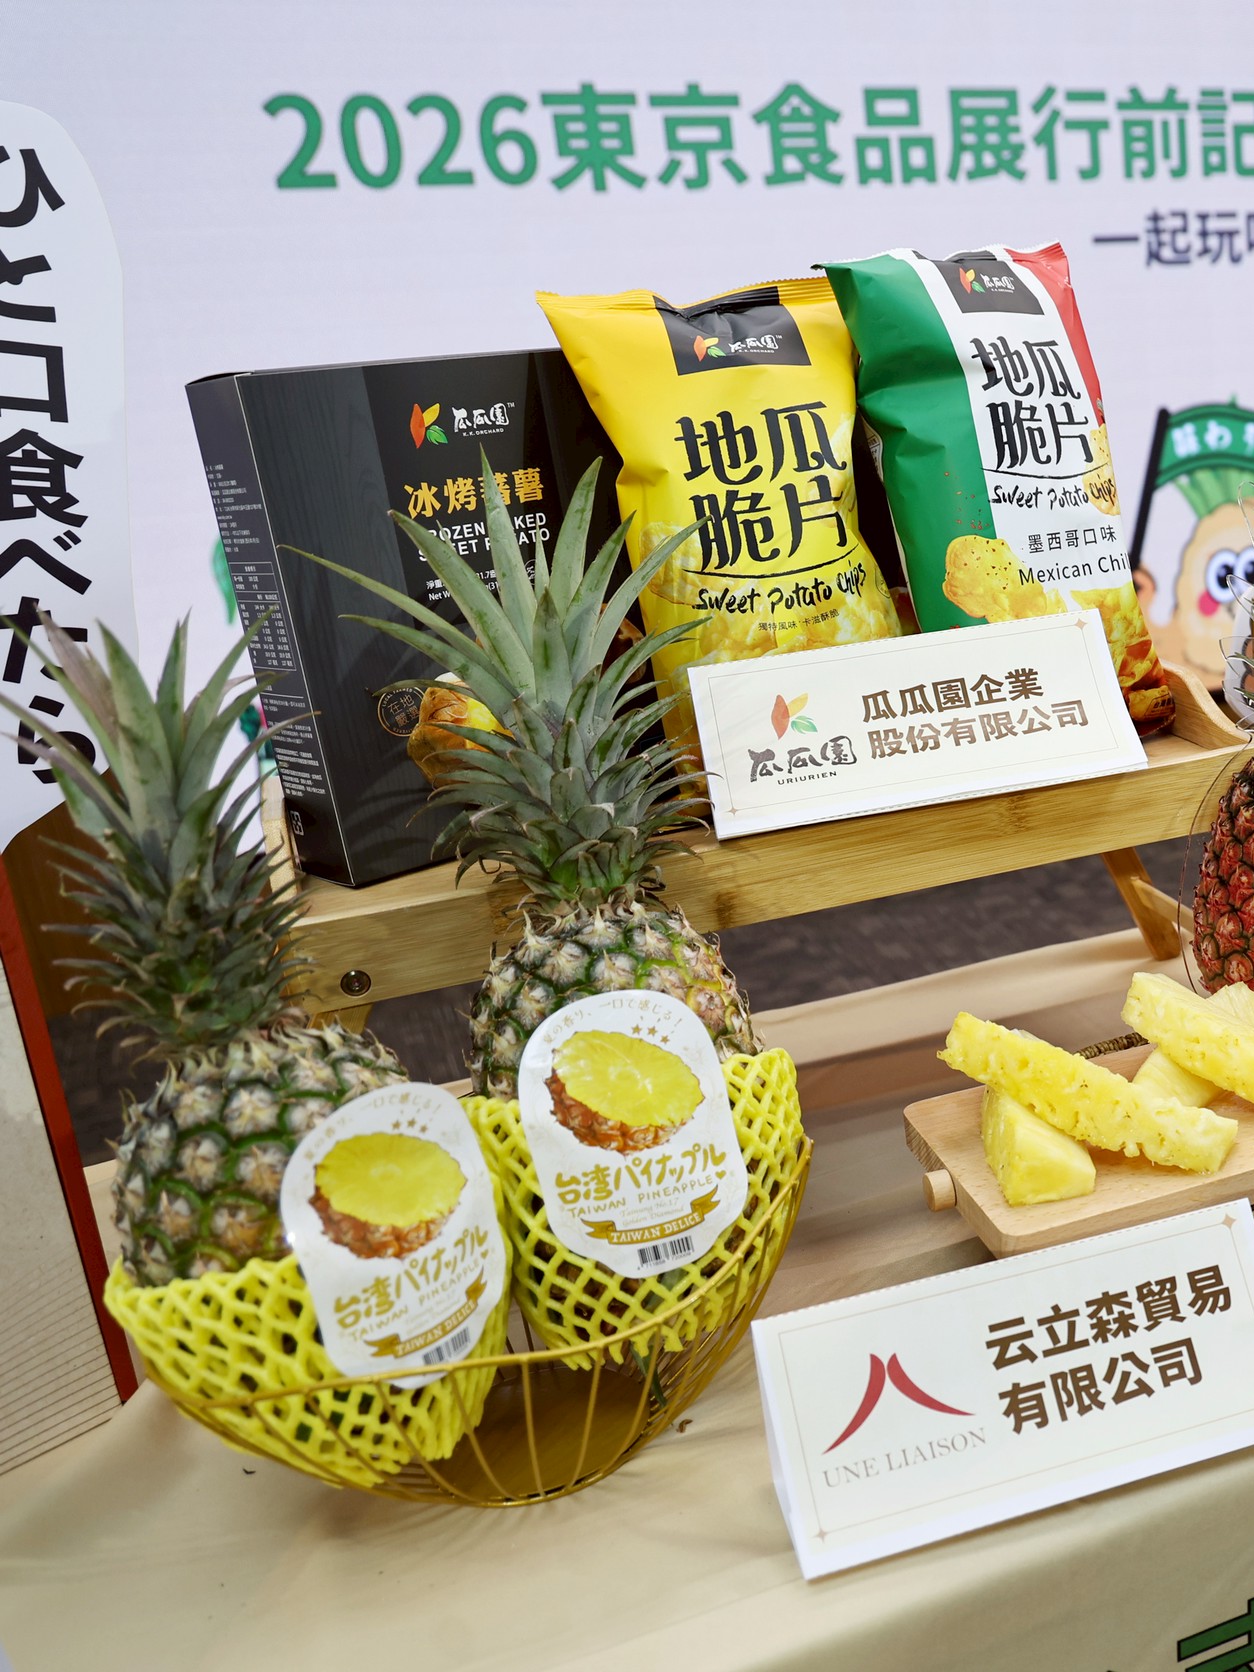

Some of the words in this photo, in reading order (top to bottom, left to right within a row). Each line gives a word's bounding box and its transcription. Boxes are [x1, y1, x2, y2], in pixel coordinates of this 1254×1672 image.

[970, 336, 1081, 399] 地瓜
[674, 401, 847, 485] 地瓜
[986, 400, 1093, 471] 脆片
[689, 475, 848, 572] 脆片
[990, 485, 1042, 509] Sweet
[1049, 485, 1089, 510] Potato
[1028, 525, 1117, 554] 墨西哥口味
[692, 588, 761, 614] Sweet
[767, 577, 832, 615] Potato
[1018, 563, 1093, 585] Mexican
[862, 667, 1044, 723] 瓜瓜園企業
[867, 700, 1089, 759] 股份有限公司
[777, 771, 837, 785] URIURIEN
[568, 1197, 626, 1219] TAIWAN
[638, 1174, 713, 1203] PINEAPPLE
[611, 1227, 660, 1243] TAIWAN
[664, 1213, 702, 1235] DELICE
[351, 1305, 408, 1341] TAIWAN
[985, 1264, 1233, 1371] 云立森貿易
[998, 1337, 1203, 1435] 有限公司
[822, 1457, 880, 1489] UNE
[885, 1427, 988, 1473] LIAISON
